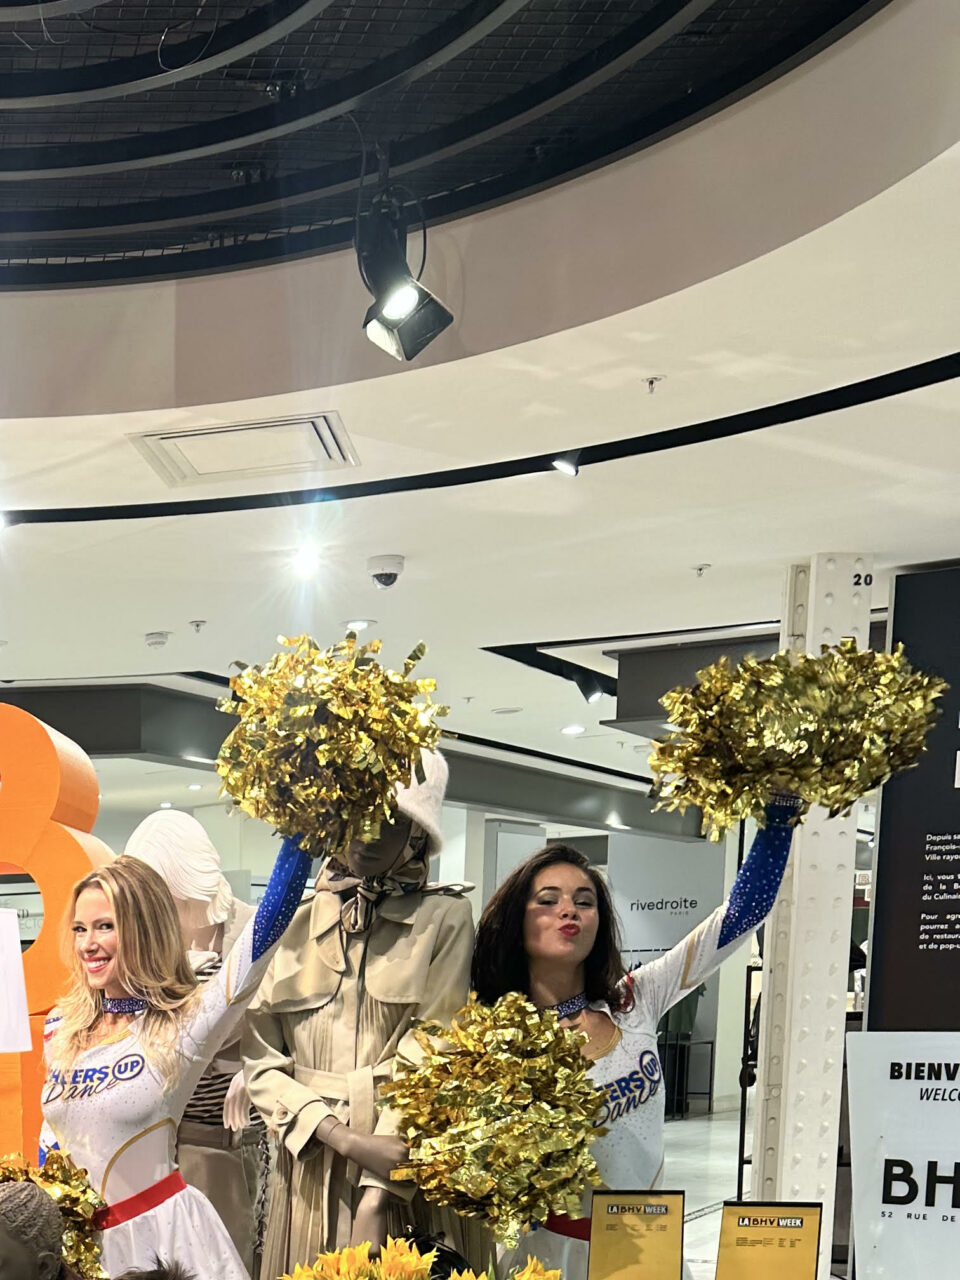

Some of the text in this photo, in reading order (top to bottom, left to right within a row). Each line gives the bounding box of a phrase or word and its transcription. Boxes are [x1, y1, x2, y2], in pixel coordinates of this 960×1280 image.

[853, 573, 873, 587] 20
[926, 833, 952, 842] Depuis
[924, 853, 960, 862] Ville rayo
[922, 883, 933, 891] de
[939, 882, 947, 890] la
[922, 893, 932, 901] du
[630, 897, 698, 912] rivedroite
[919, 923, 949, 932] pourrez
[919, 932, 930, 940] de
[918, 942, 927, 950] et
[928, 941, 938, 950] de
[117, 1060, 141, 1075] UP
[643, 1057, 658, 1078] UP
[889, 1061, 960, 1082] BIENV
[43, 1077, 119, 1105] Dance
[608, 1204, 668, 1214] LA BHV WEEK
[881, 1210, 957, 1223] 52 RUE DE
[738, 1217, 802, 1227] LA BHV WEEK
